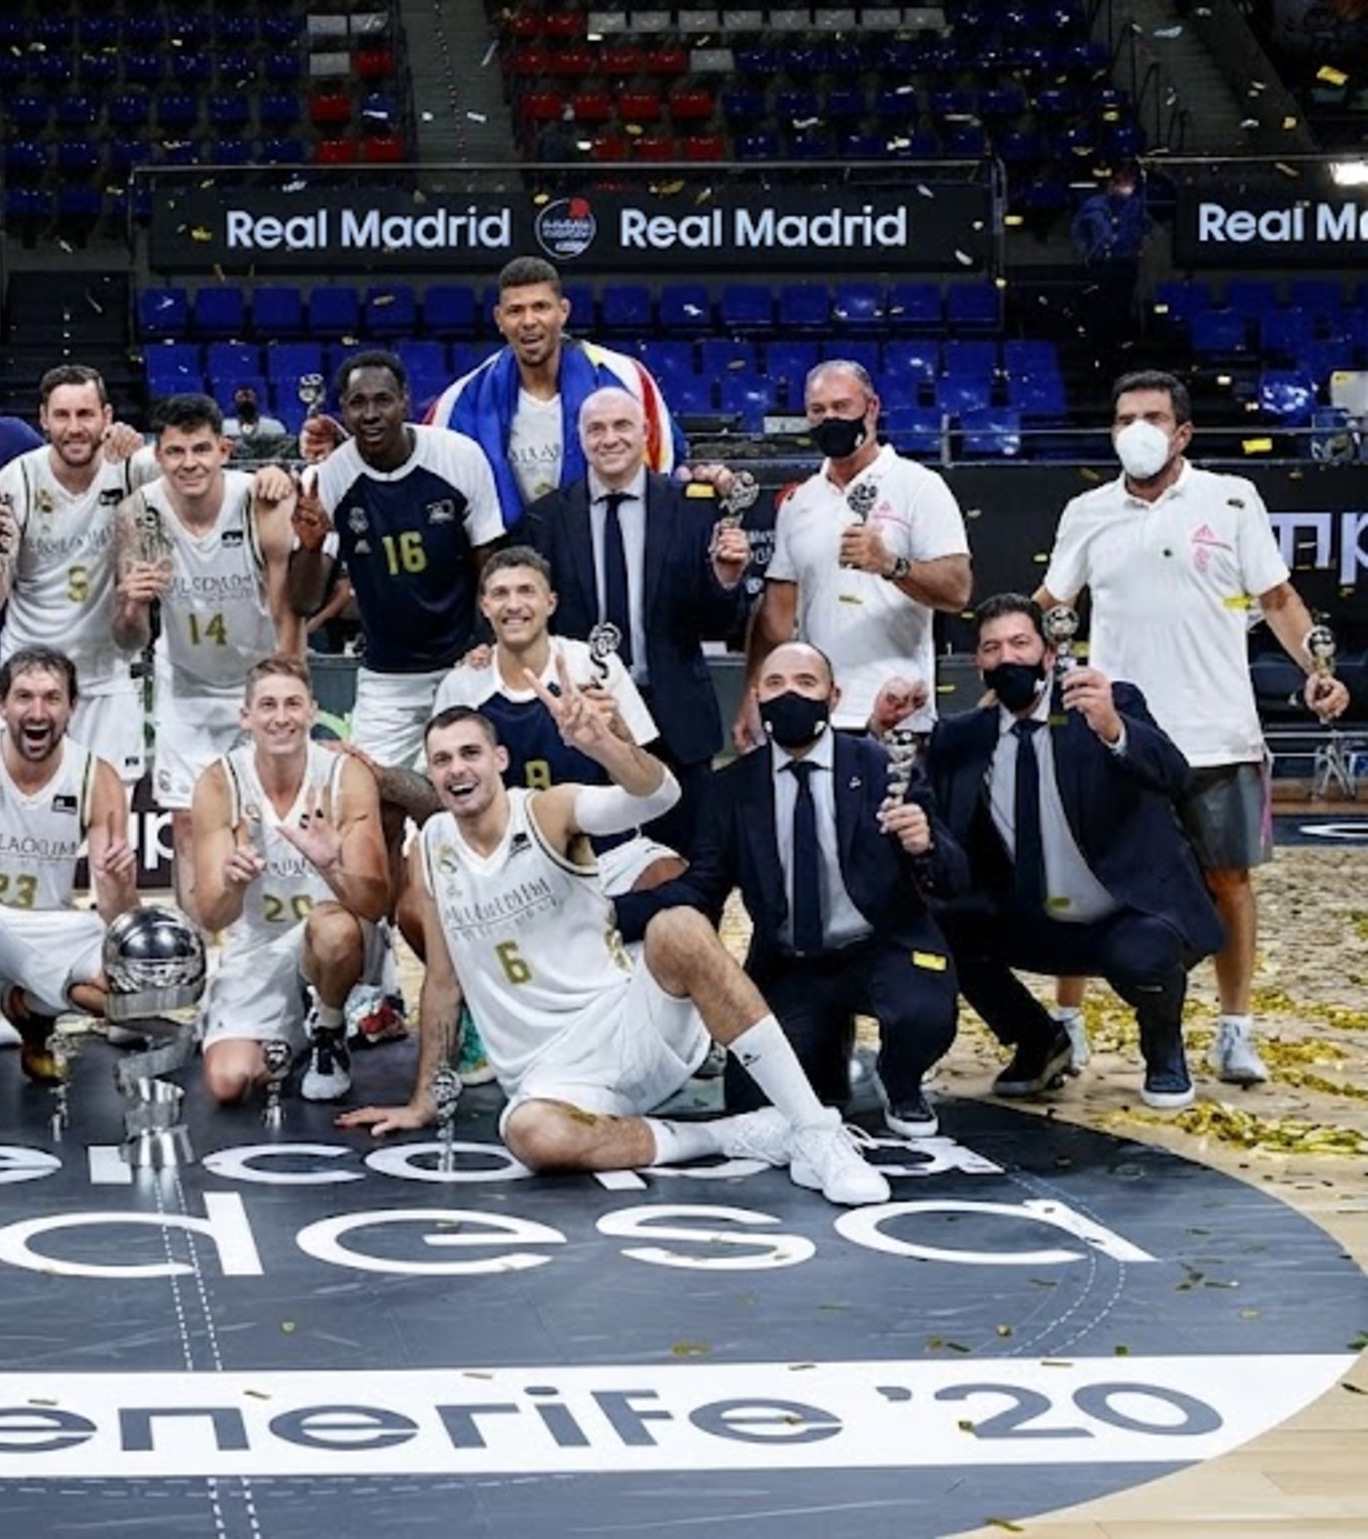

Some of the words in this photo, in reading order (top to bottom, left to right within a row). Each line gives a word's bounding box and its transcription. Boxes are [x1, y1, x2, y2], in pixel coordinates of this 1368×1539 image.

[227, 209, 327, 248] Real
[341, 207, 511, 249] Madrid
[621, 208, 722, 248] Real
[735, 205, 907, 247] Madrid
[1198, 202, 1305, 242] Real
[1316, 202, 1368, 241] M
[382, 530, 428, 575] 16
[188, 611, 228, 646] 14
[494, 939, 533, 985] 6
